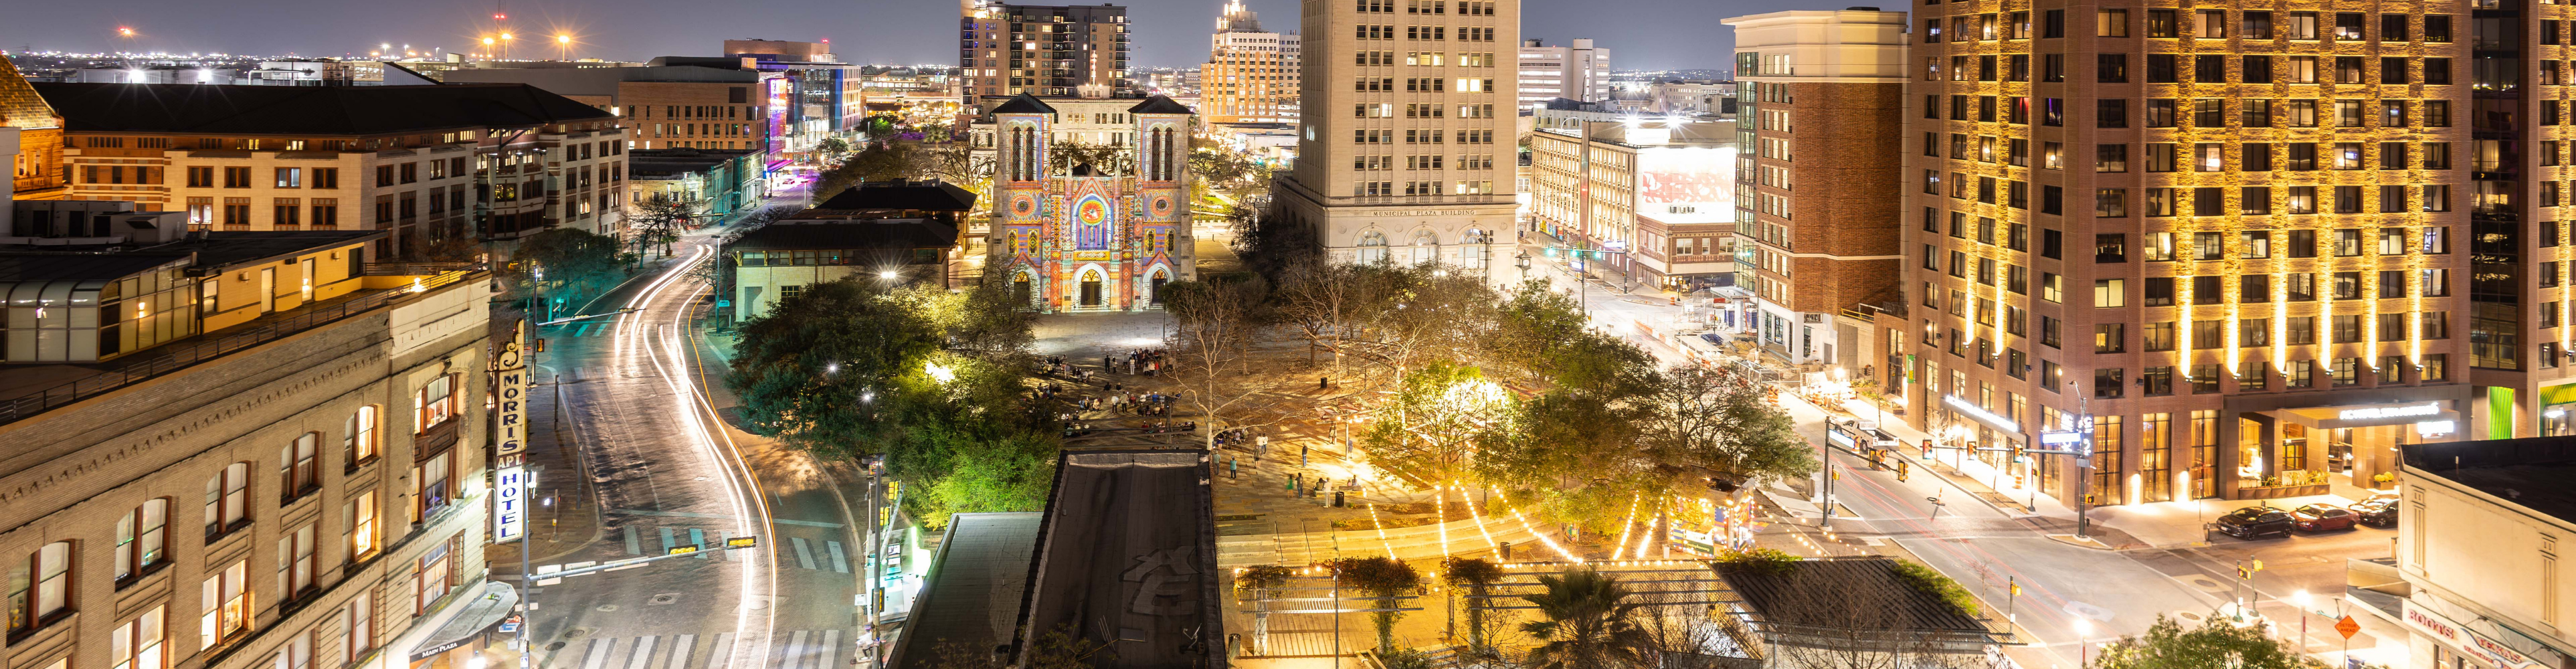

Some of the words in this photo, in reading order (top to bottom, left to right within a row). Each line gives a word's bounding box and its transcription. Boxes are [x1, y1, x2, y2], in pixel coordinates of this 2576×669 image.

[503, 374, 519, 452] MORRIS
[501, 473, 517, 538] HOTEL
[2409, 609, 2454, 639] BOOTS
[422, 648, 439, 658] MAIN
[439, 642, 458, 654] PLAZA
[2477, 636, 2522, 663] TEXAS
